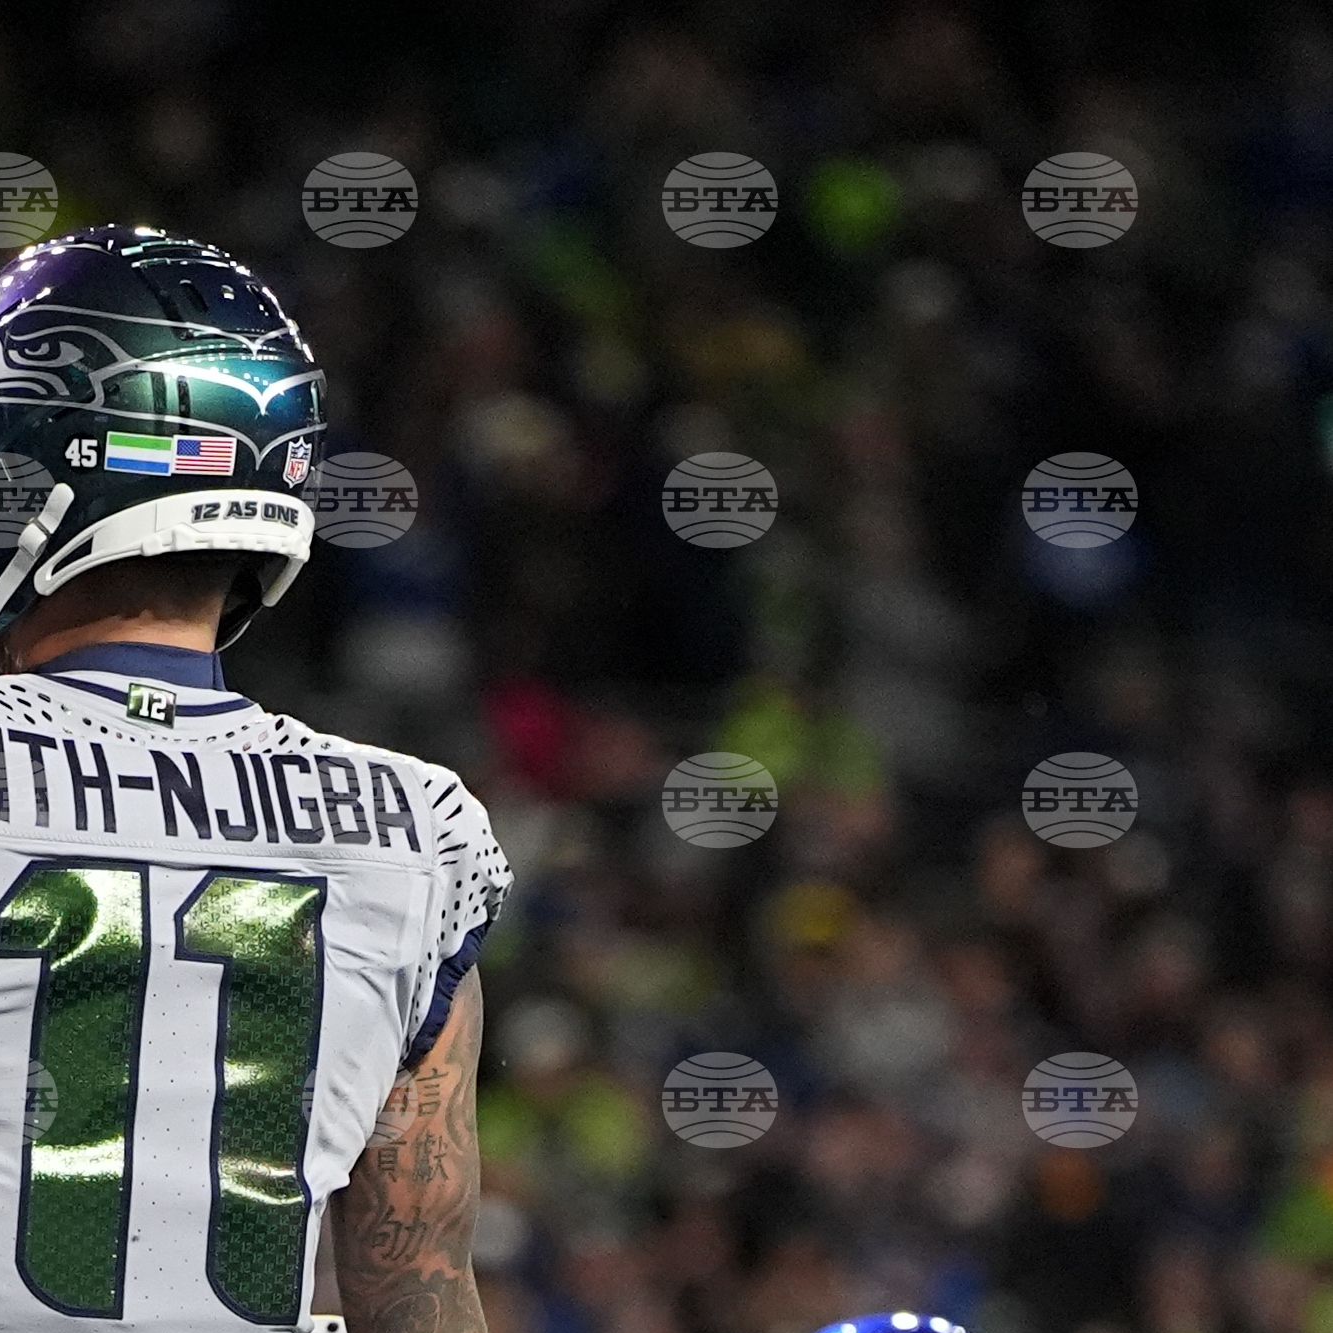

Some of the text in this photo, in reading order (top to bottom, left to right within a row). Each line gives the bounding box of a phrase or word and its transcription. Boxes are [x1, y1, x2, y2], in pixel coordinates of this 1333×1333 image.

[65, 438, 98, 468] 45
[288, 460, 306, 480] NFL
[191, 500, 299, 528] 12 AS ONE
[135, 690, 167, 721] 12
